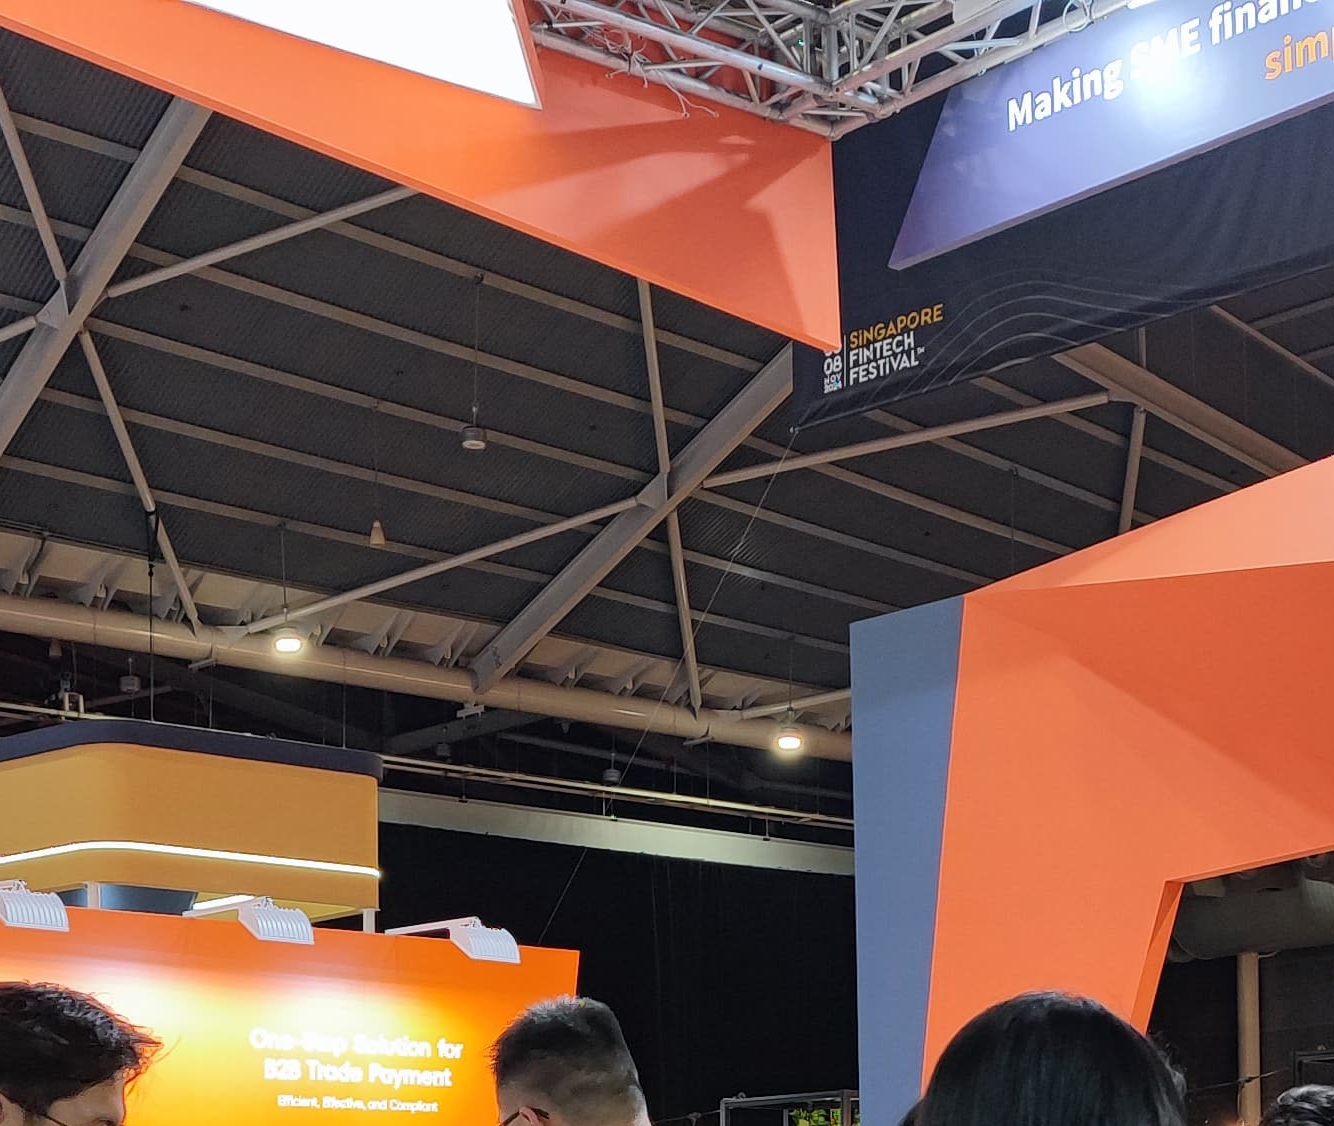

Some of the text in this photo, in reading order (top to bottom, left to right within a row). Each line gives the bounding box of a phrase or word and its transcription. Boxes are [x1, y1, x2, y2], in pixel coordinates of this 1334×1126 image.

[1008, 59, 1123, 132] Making
[1130, 17, 1202, 80] SME
[849, 330, 915, 368] FINTECH
[354, 1033, 432, 1058] Solution
[437, 1038, 464, 1059] for
[263, 1057, 452, 1089] B2B Trade Payment
[367, 1099, 388, 1110] and
